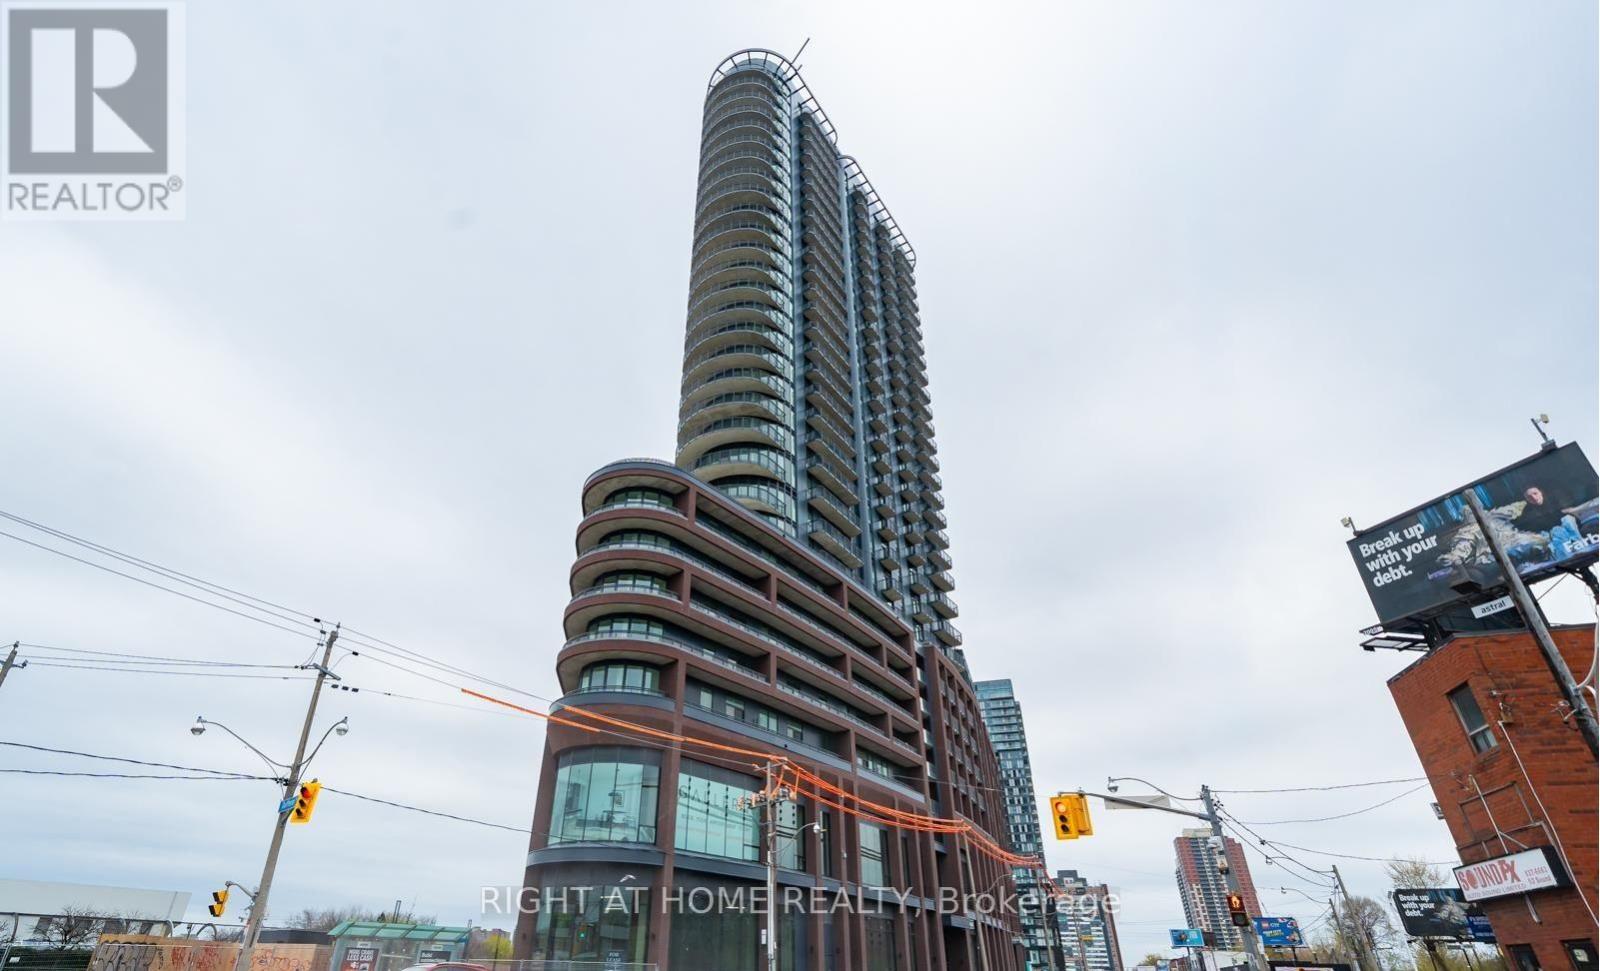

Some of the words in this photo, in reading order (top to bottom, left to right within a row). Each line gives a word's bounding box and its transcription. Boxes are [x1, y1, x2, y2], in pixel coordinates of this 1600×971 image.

[1359, 531, 1403, 558] Break
[1403, 523, 1425, 539] up
[1366, 549, 1402, 572] with
[1401, 535, 1438, 562] your
[1373, 564, 1413, 587] debt.
[1481, 600, 1506, 614] astral
[1398, 894, 1419, 902] Break
